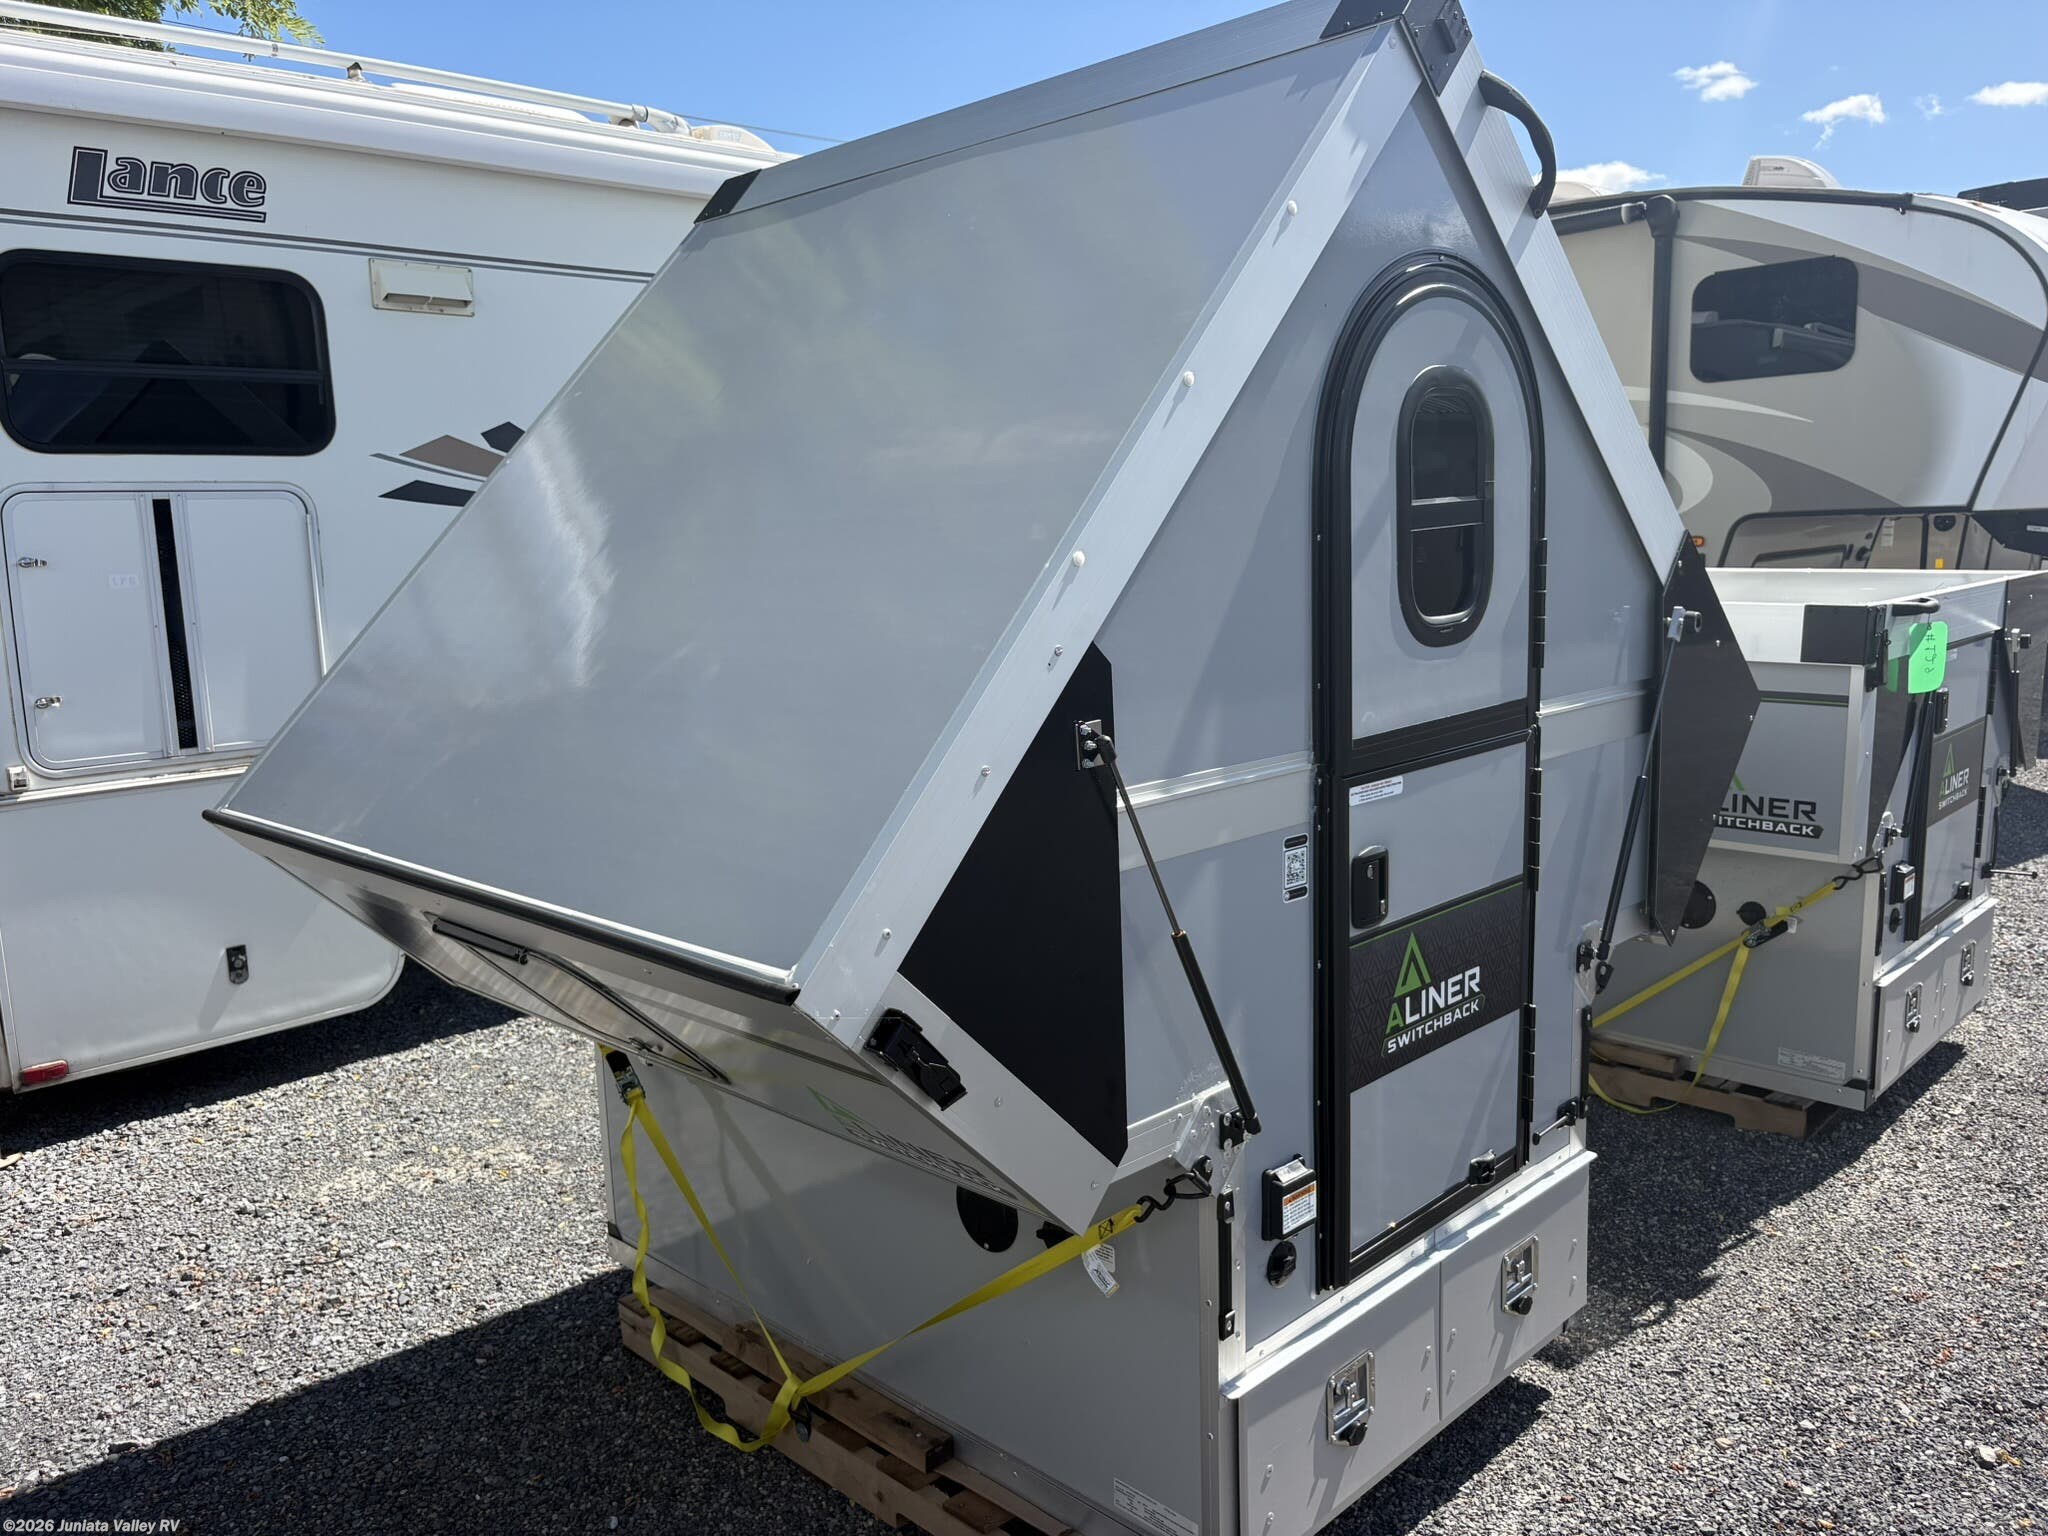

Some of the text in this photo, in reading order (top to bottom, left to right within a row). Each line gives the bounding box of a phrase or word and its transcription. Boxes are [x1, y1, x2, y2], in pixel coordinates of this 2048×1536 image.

[67, 146, 267, 223] Lance
[1939, 767, 1970, 799] ALINER
[1713, 814, 1815, 836] ITCHBACK
[1385, 966, 1480, 1035] ALINER
[1387, 999, 1480, 1054] SWITCHBACK
